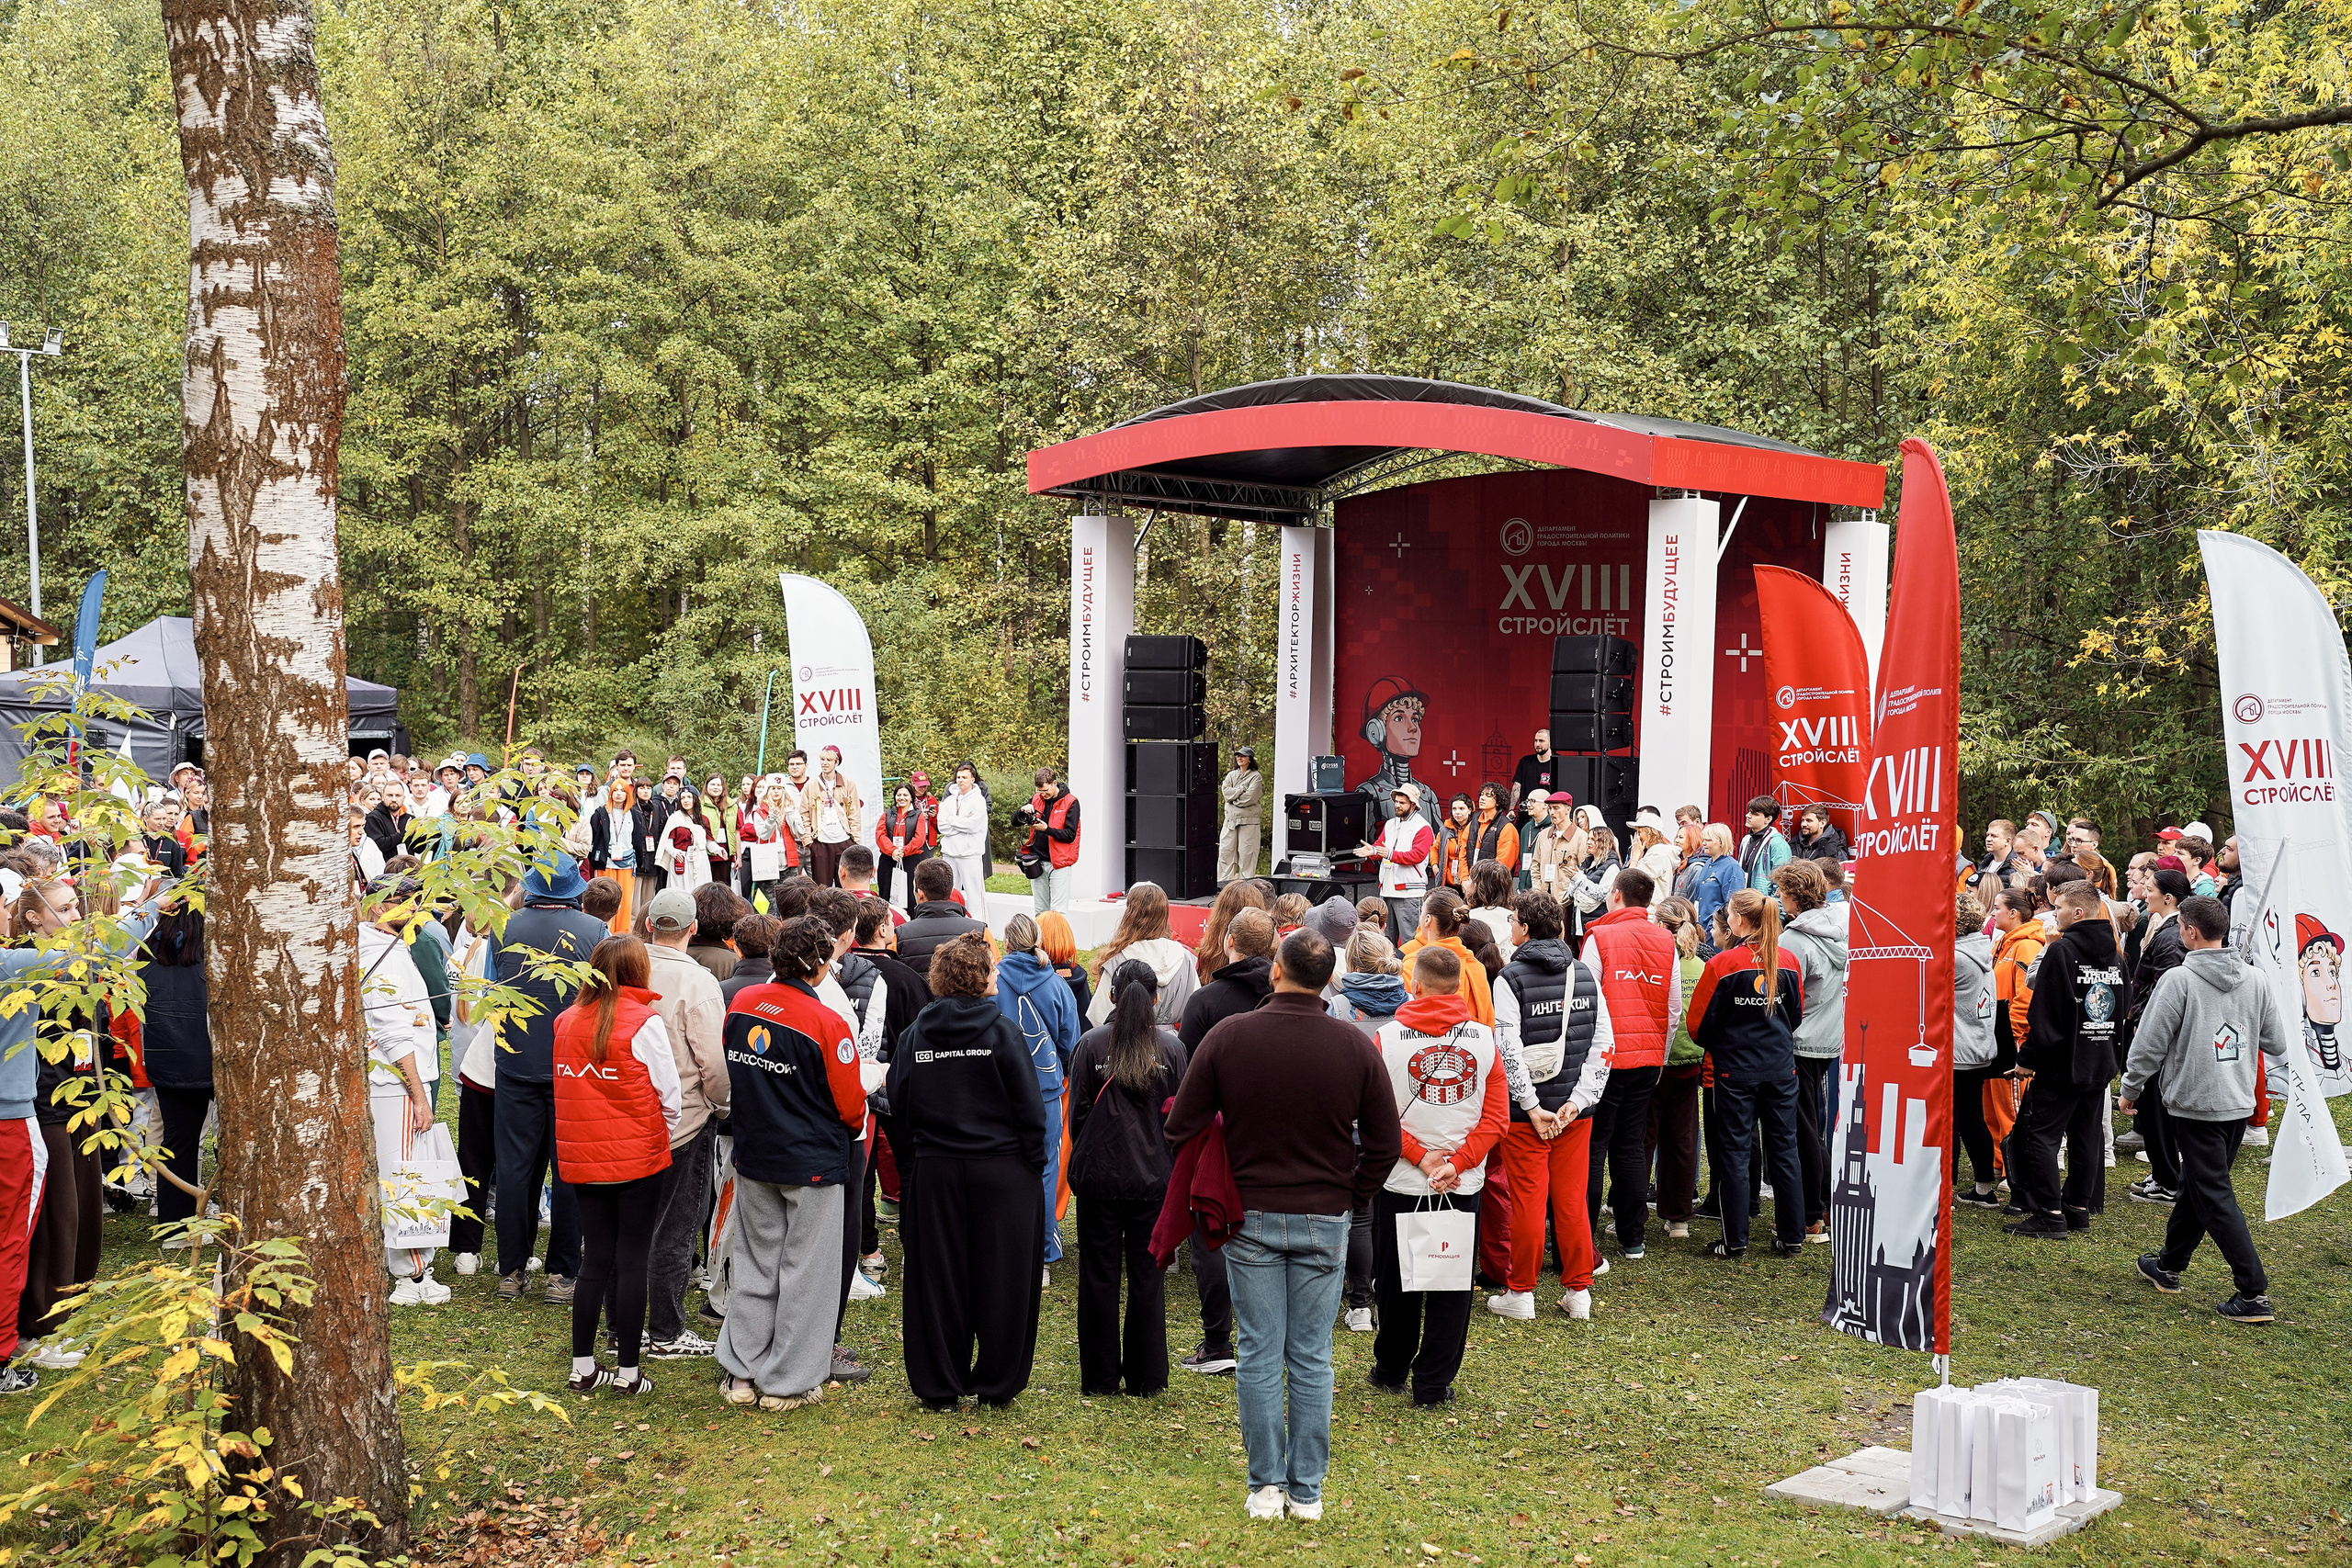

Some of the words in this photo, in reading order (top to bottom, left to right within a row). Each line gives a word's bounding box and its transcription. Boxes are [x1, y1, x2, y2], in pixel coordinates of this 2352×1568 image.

[1499, 564, 1630, 610] XVIII
[1081, 547, 1093, 703] #СТРОИМБУДУЩЕЕ
[1289, 553, 1301, 699] #АРХИТЕКТОРЖИЗНИ
[1498, 612, 1630, 636] СТРОЙСЛЁТ
[1660, 535, 1679, 716] #СТРОИМБУДУЩЕЕ
[799, 688, 861, 716] XVIII
[799, 712, 863, 728] СТРОЙСЛЁТ
[1778, 716, 1859, 751] XVIII
[1779, 748, 1860, 768] СТРОЙСЛЁТ
[2238, 739, 2333, 783] XVIII
[1856, 818, 1939, 861] ТРОЙСЛЁТ
[1615, 969, 1663, 986] ГАЛС
[935, 1049, 965, 1059] CAPITAL
[557, 1062, 619, 1080] ГАЛС
